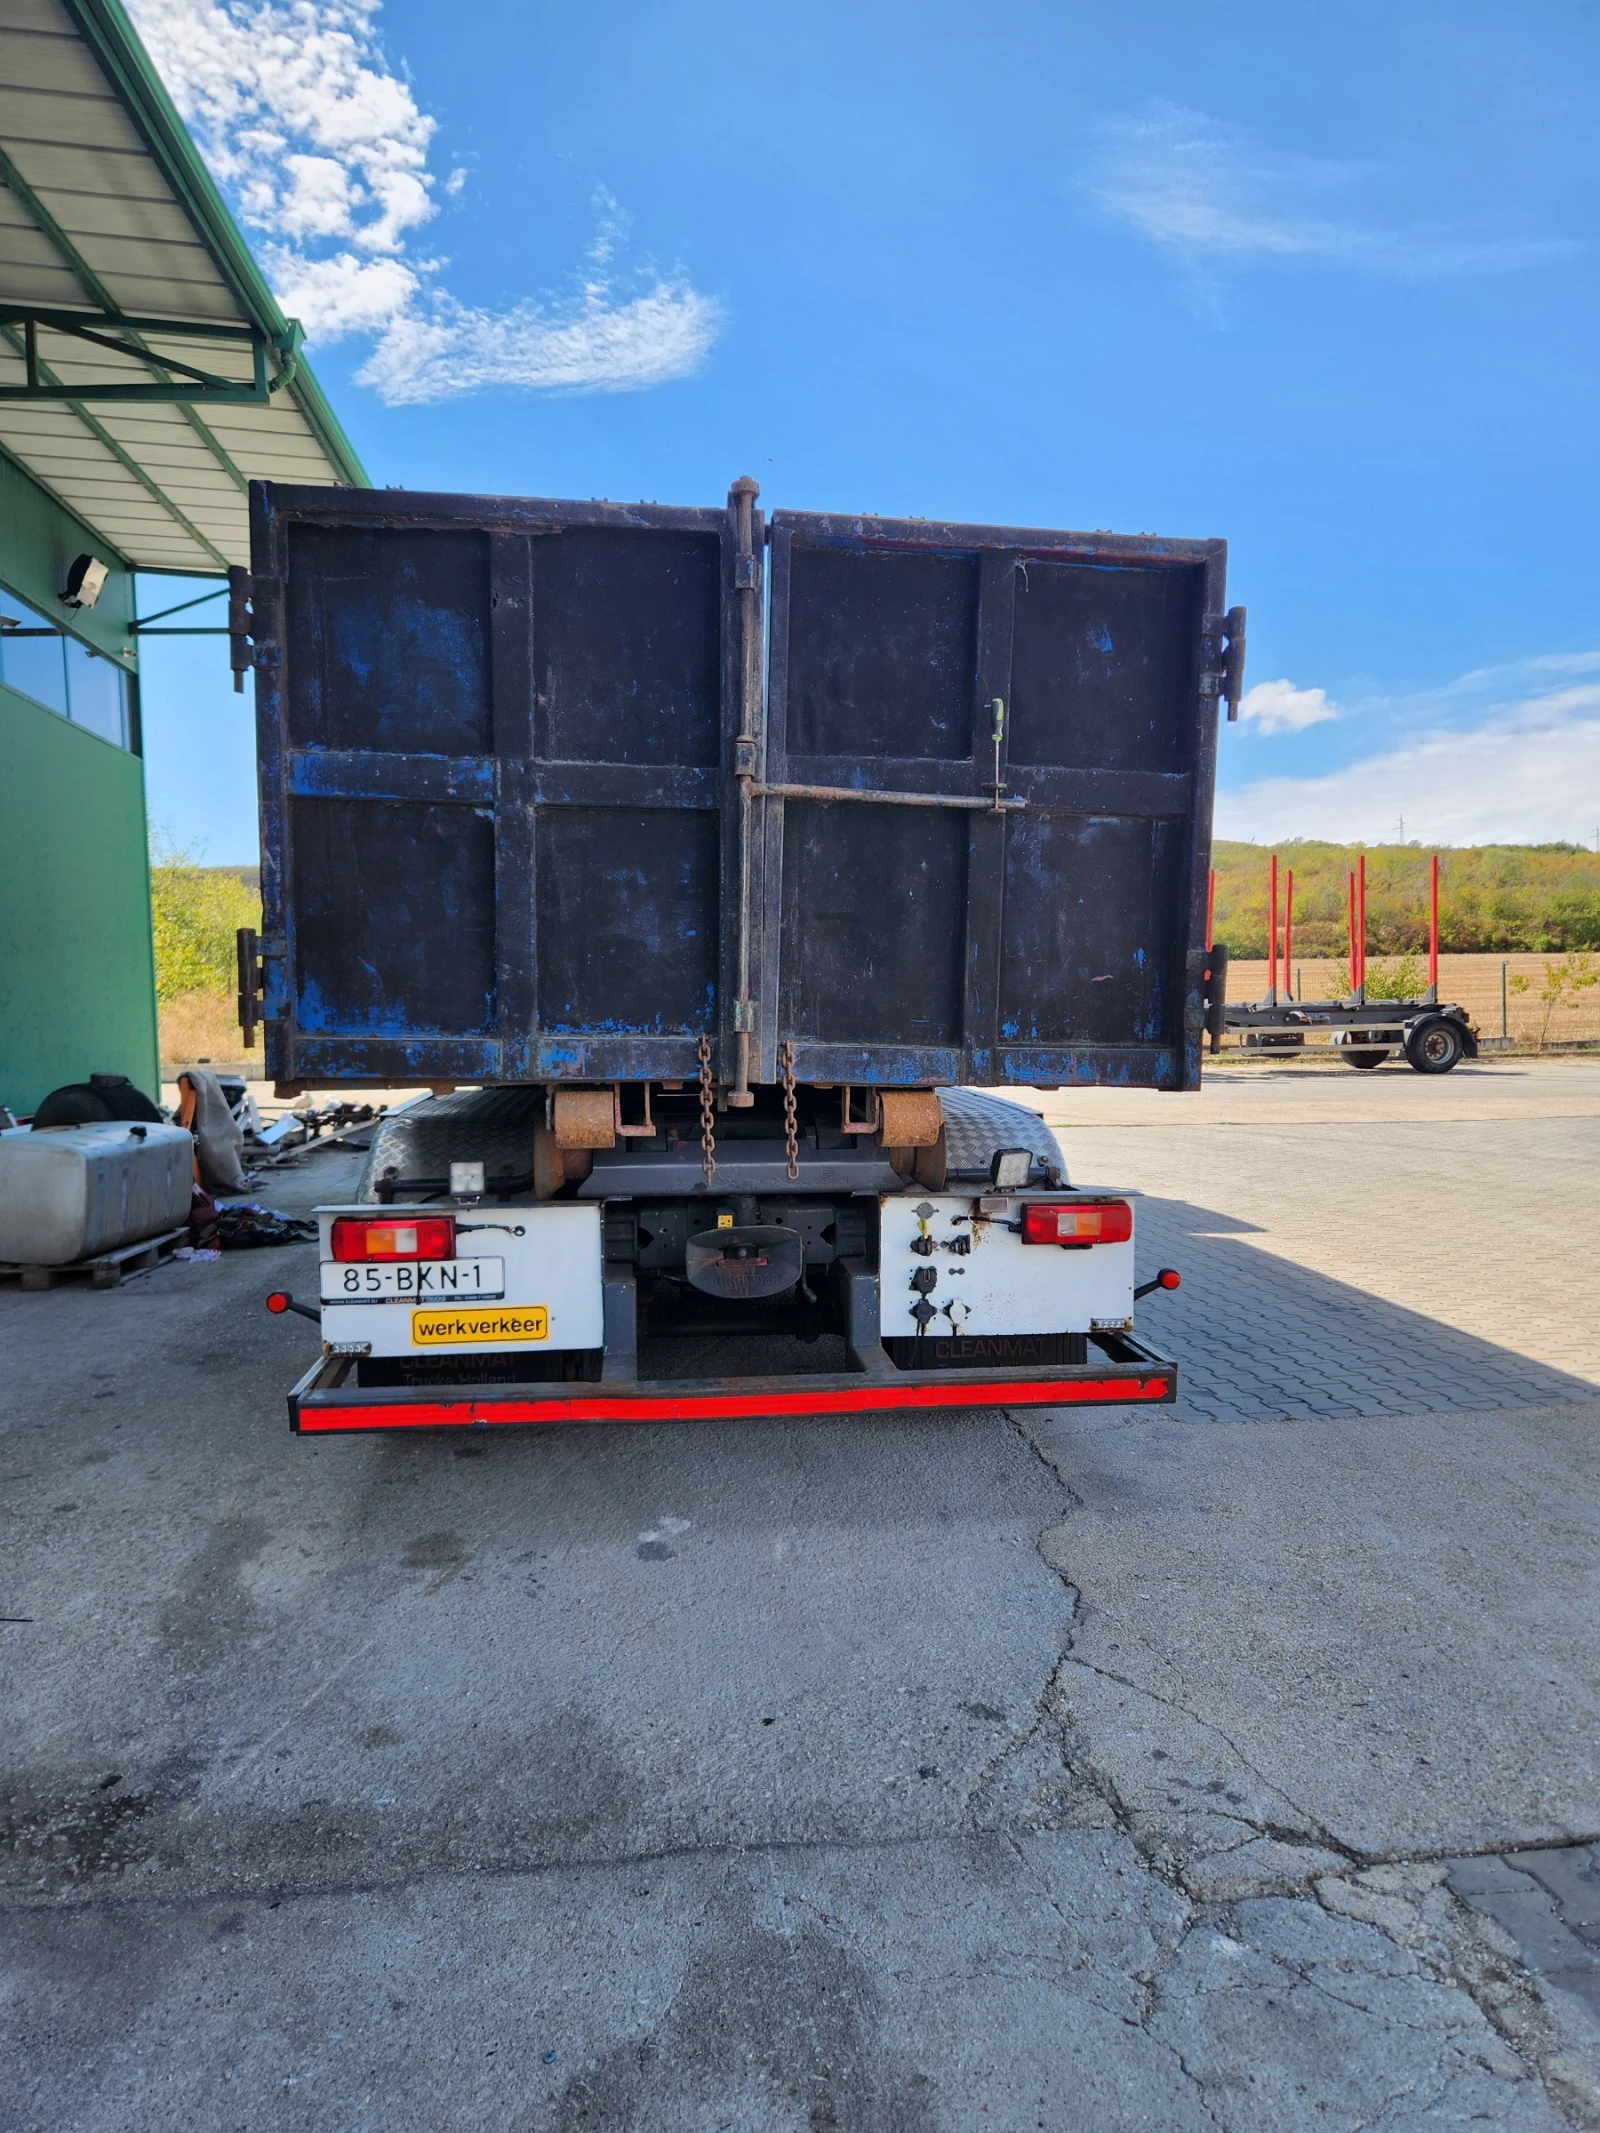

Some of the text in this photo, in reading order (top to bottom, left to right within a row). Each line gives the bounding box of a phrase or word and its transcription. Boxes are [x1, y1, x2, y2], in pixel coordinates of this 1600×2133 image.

[344, 1264, 481, 1291] 85-BKN-1
[385, 1296, 425, 1304] CLEANMT
[419, 1316, 543, 1336] werkverkeer
[935, 1338, 1046, 1359] CLEANMAT
